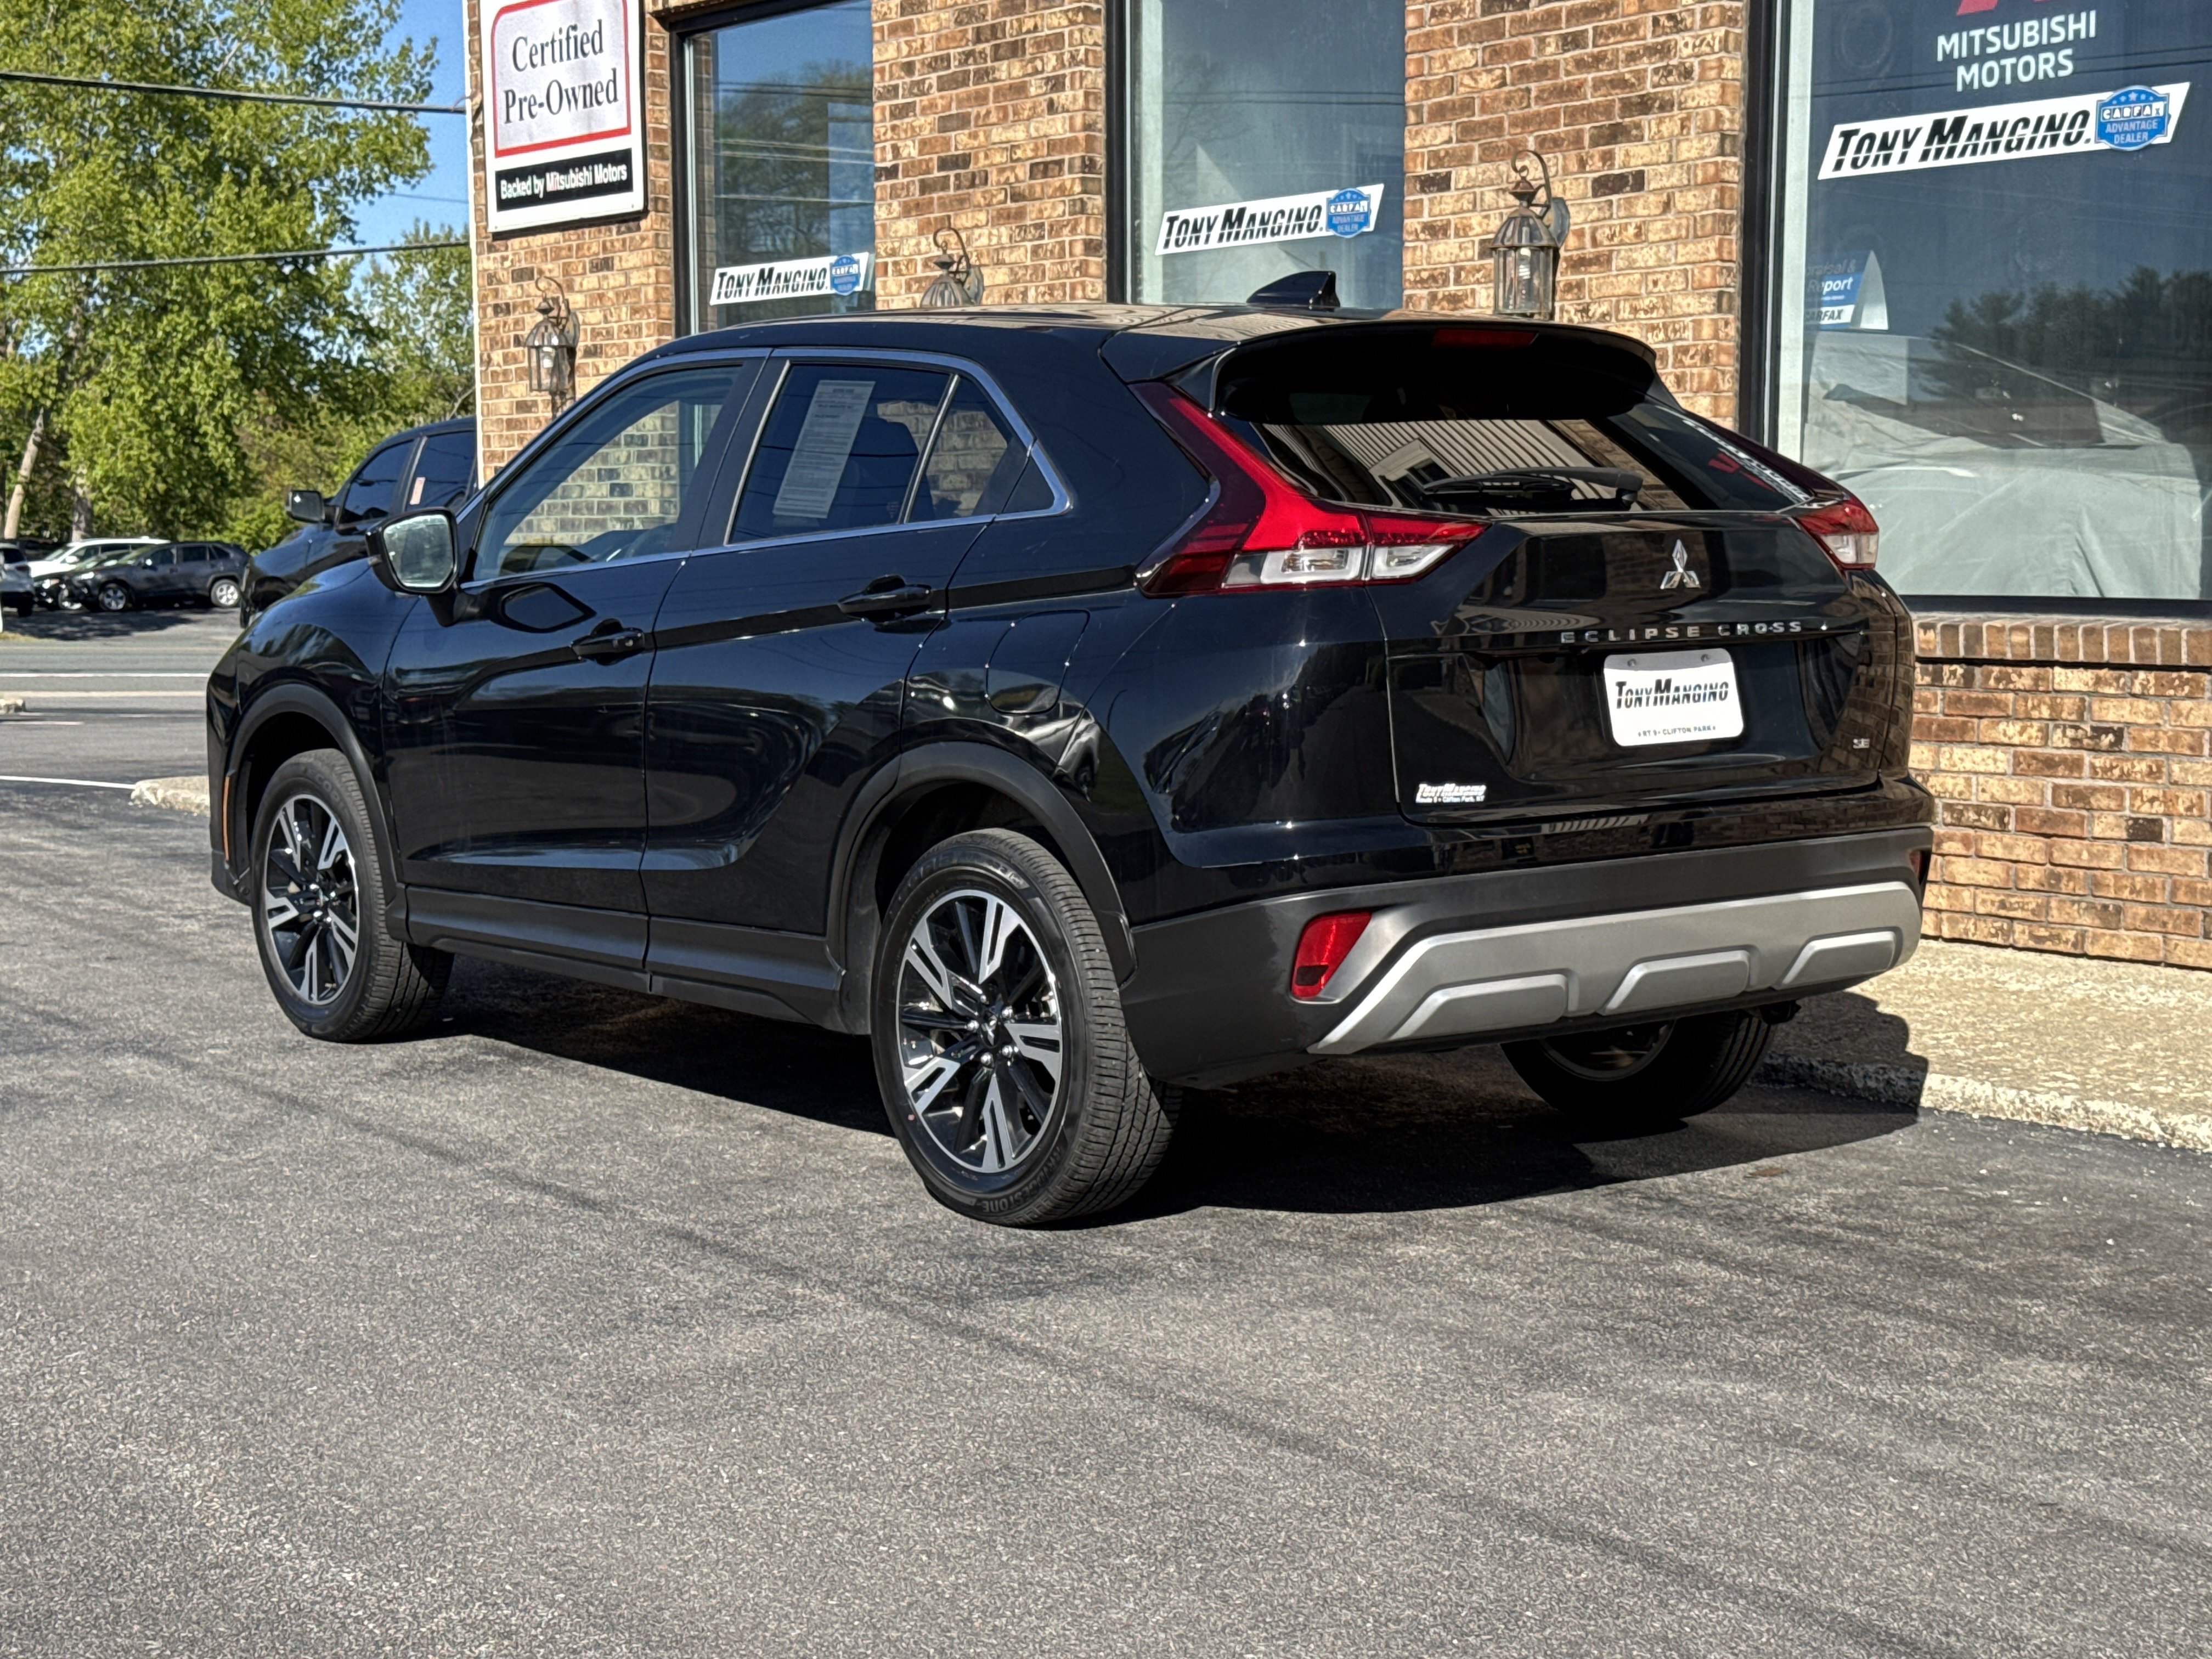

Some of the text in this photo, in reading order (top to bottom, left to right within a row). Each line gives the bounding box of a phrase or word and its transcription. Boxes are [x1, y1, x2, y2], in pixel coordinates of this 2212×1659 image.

[512, 19, 604, 72] Certified
[1937, 10, 2096, 61] MITSUBISHI
[1956, 49, 2074, 92] MOTORS
[504, 67, 619, 124] Pre-Owned
[2102, 101, 2164, 121] CARFAX
[2105, 119, 2158, 133] ADVANTAGE
[2114, 132, 2148, 144] DEALER
[1832, 126, 1923, 172] TONY
[500, 163, 628, 200] Backed by Mitsubishi Motors
[1163, 215, 1219, 250] TONY
[716, 271, 755, 300] TONY
[1561, 621, 1802, 644] ECLIPSE CROSS
[1853, 738, 1870, 749] SE
